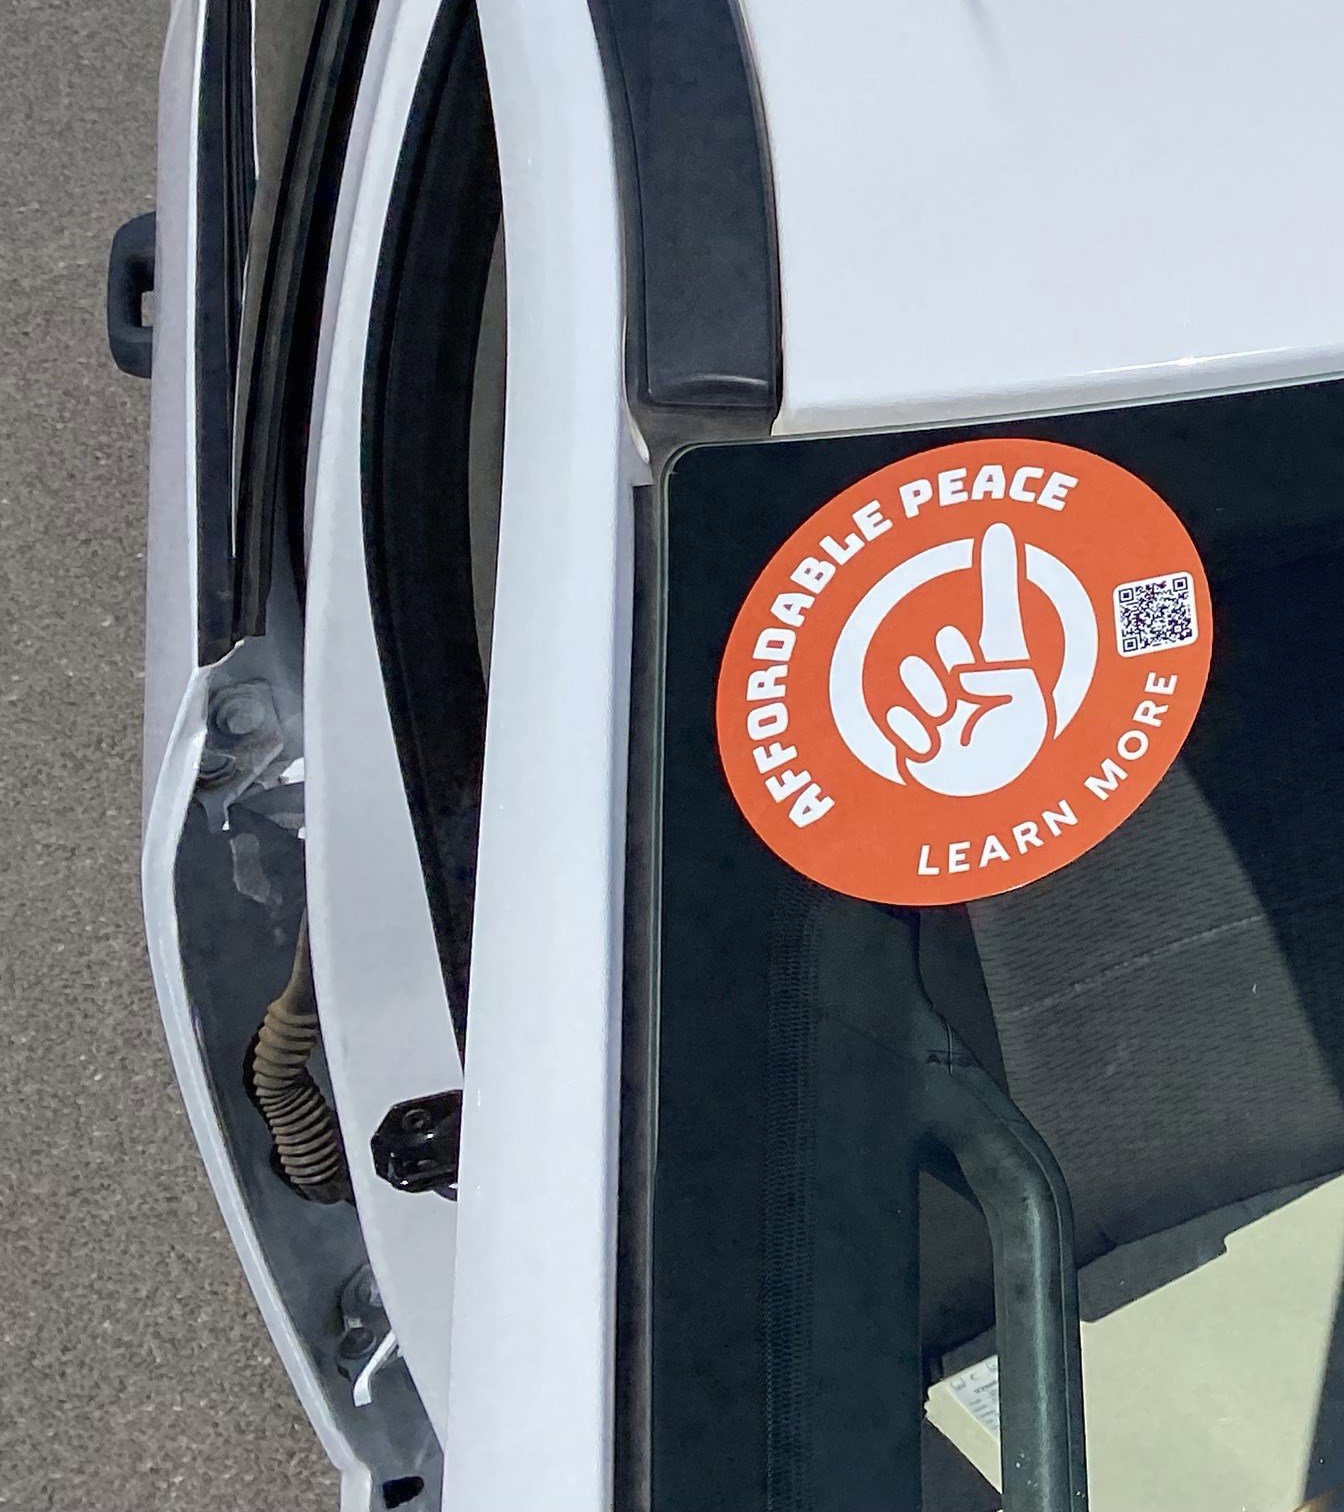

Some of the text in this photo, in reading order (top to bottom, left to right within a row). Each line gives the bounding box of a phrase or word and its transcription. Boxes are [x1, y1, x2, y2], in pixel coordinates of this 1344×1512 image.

[745, 464, 1079, 829] AFFORDABLE PEACE
[916, 671, 1179, 876] LEARN MORE
